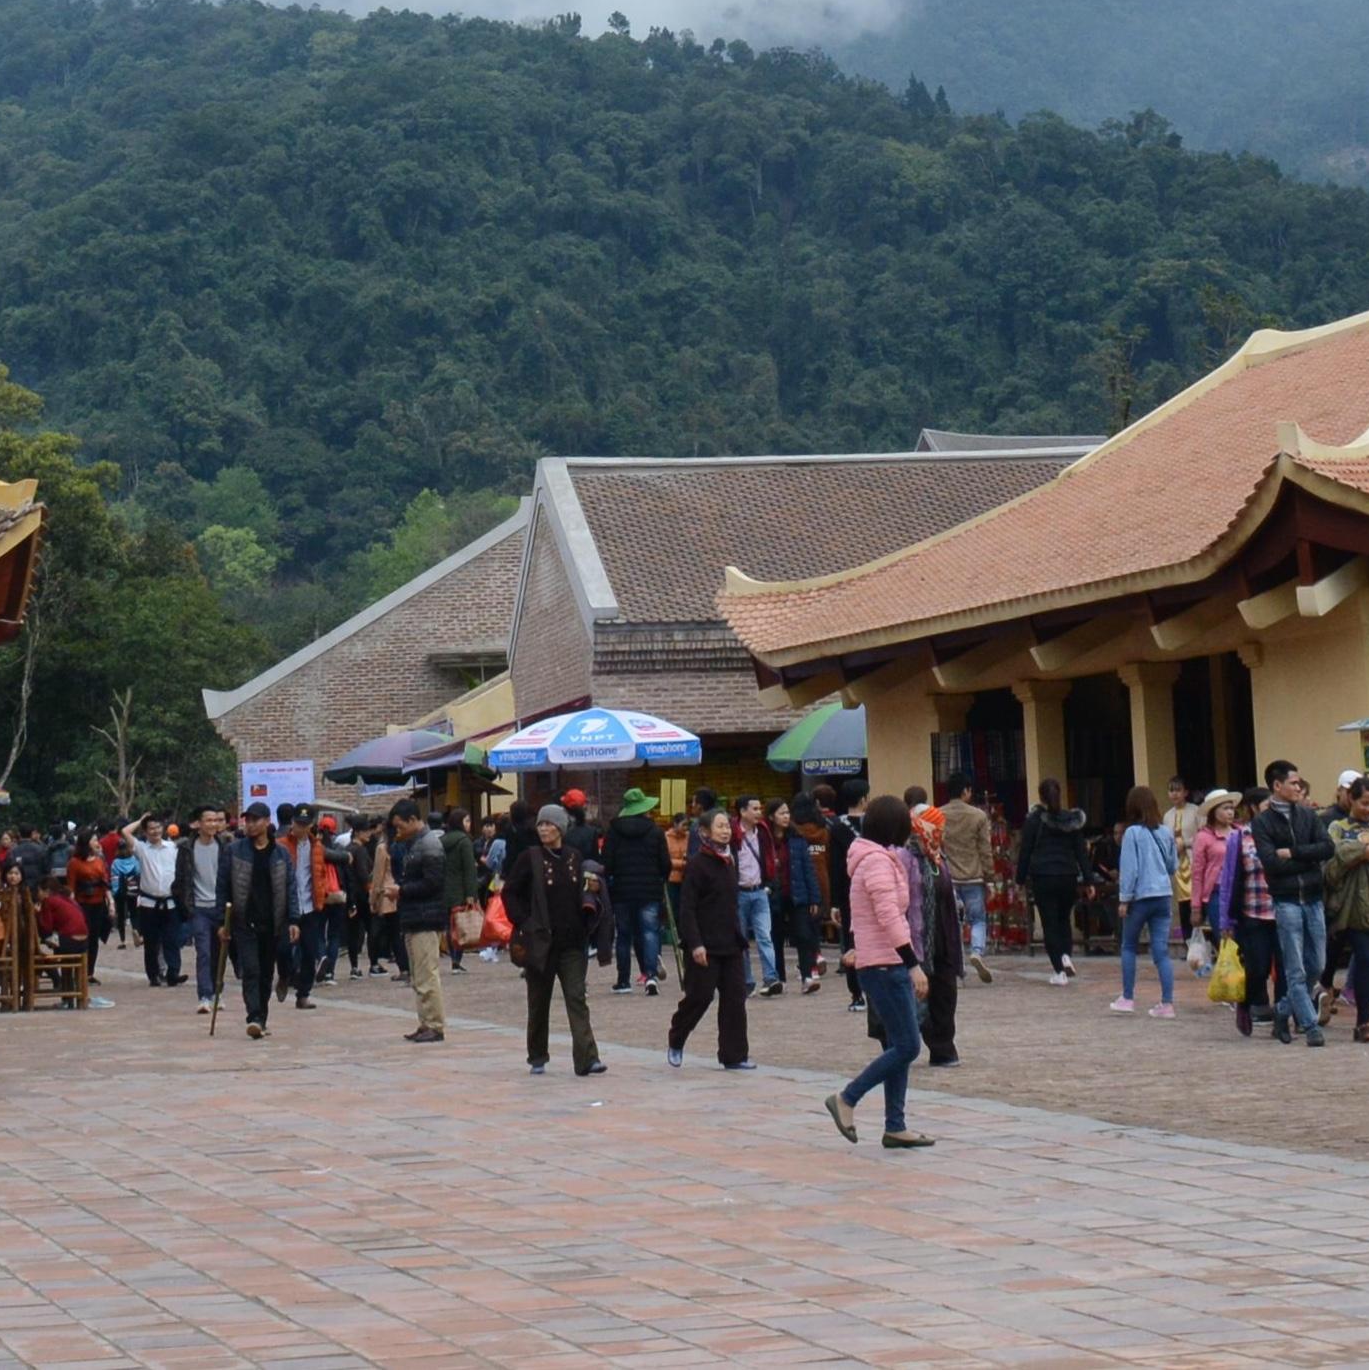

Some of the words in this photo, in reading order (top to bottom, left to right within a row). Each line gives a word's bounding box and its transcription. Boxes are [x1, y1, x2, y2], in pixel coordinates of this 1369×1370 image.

[569, 734, 615, 743] VNPT
[561, 746, 618, 761] vinaphone
[645, 742, 688, 755] vinaphone
